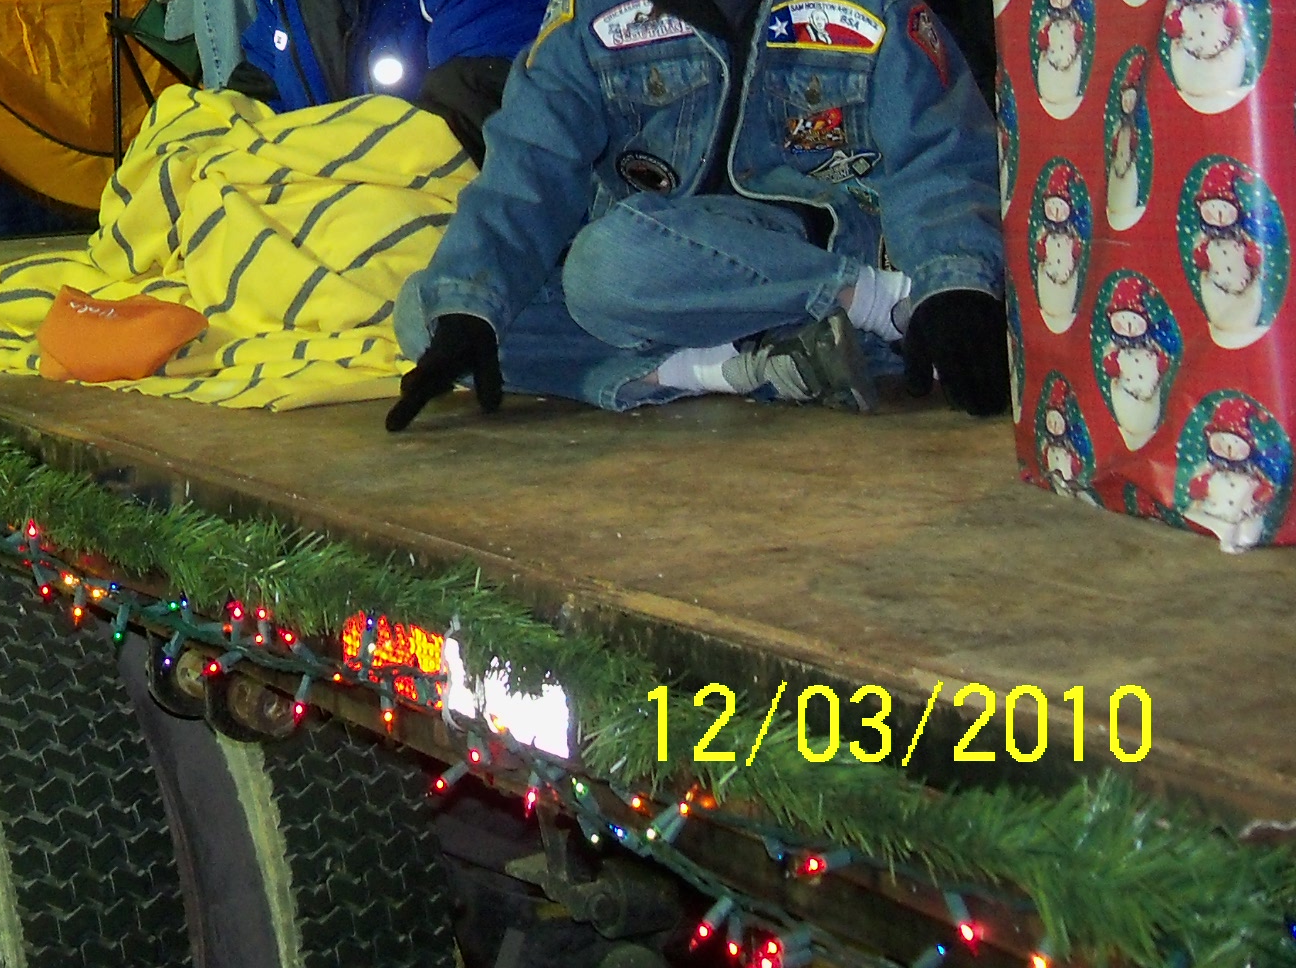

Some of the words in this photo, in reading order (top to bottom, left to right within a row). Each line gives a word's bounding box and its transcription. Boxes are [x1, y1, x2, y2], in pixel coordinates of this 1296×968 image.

[790, 2, 804, 12] SAM
[805, 2, 835, 11] HOUSTON
[840, 15, 859, 30] BSA
